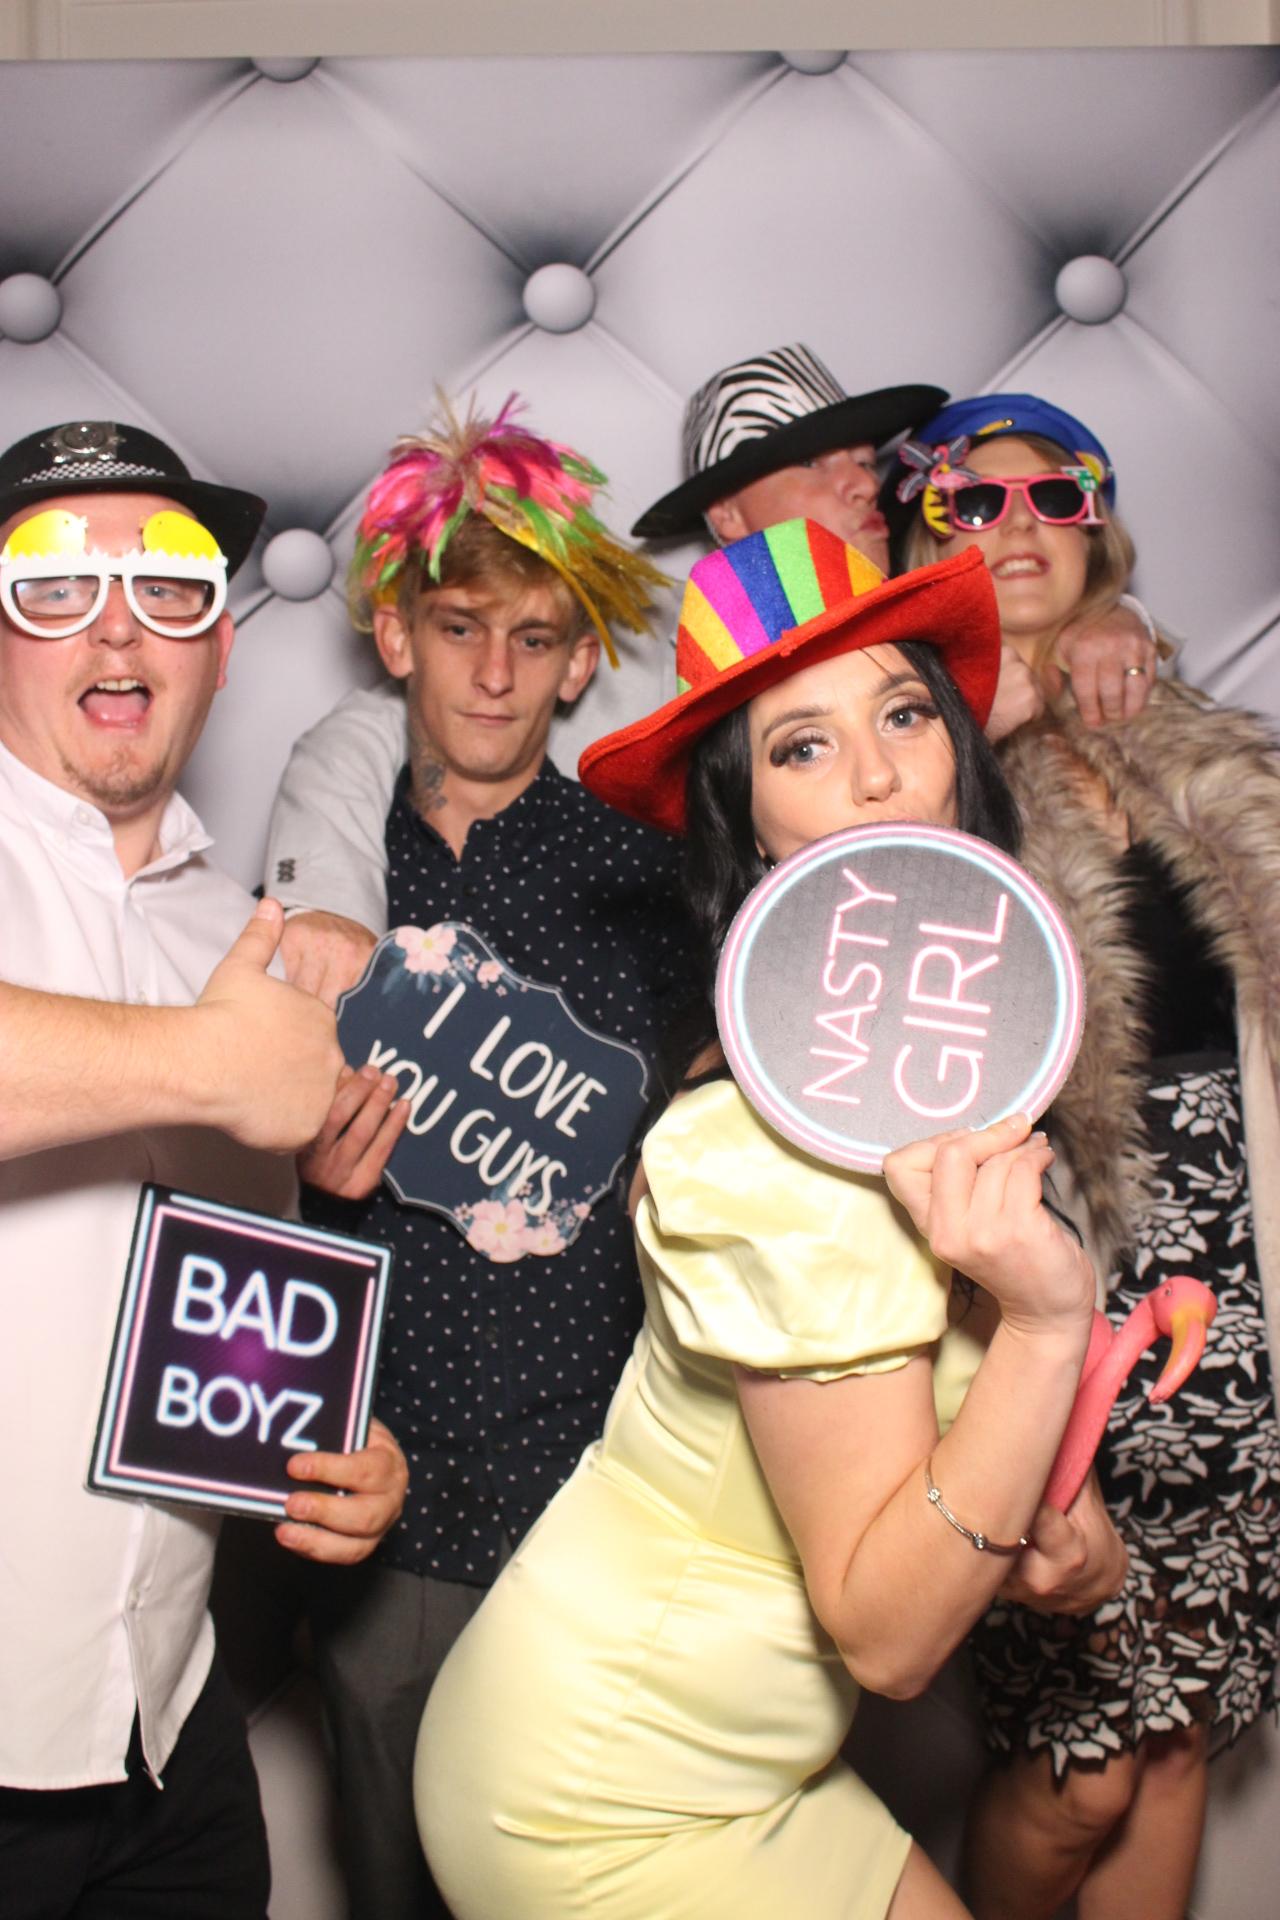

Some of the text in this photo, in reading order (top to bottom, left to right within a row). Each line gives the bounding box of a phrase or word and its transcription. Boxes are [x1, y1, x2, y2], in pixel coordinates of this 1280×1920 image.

[802, 867, 897, 1105] NASTY
[893, 892, 1008, 1118] GIRL
[423, 982, 608, 1138] I LOVE
[450, 1108, 567, 1215] GUYS
[172, 1253, 339, 1357] BAD
[156, 1364, 323, 1452] BOYZ
